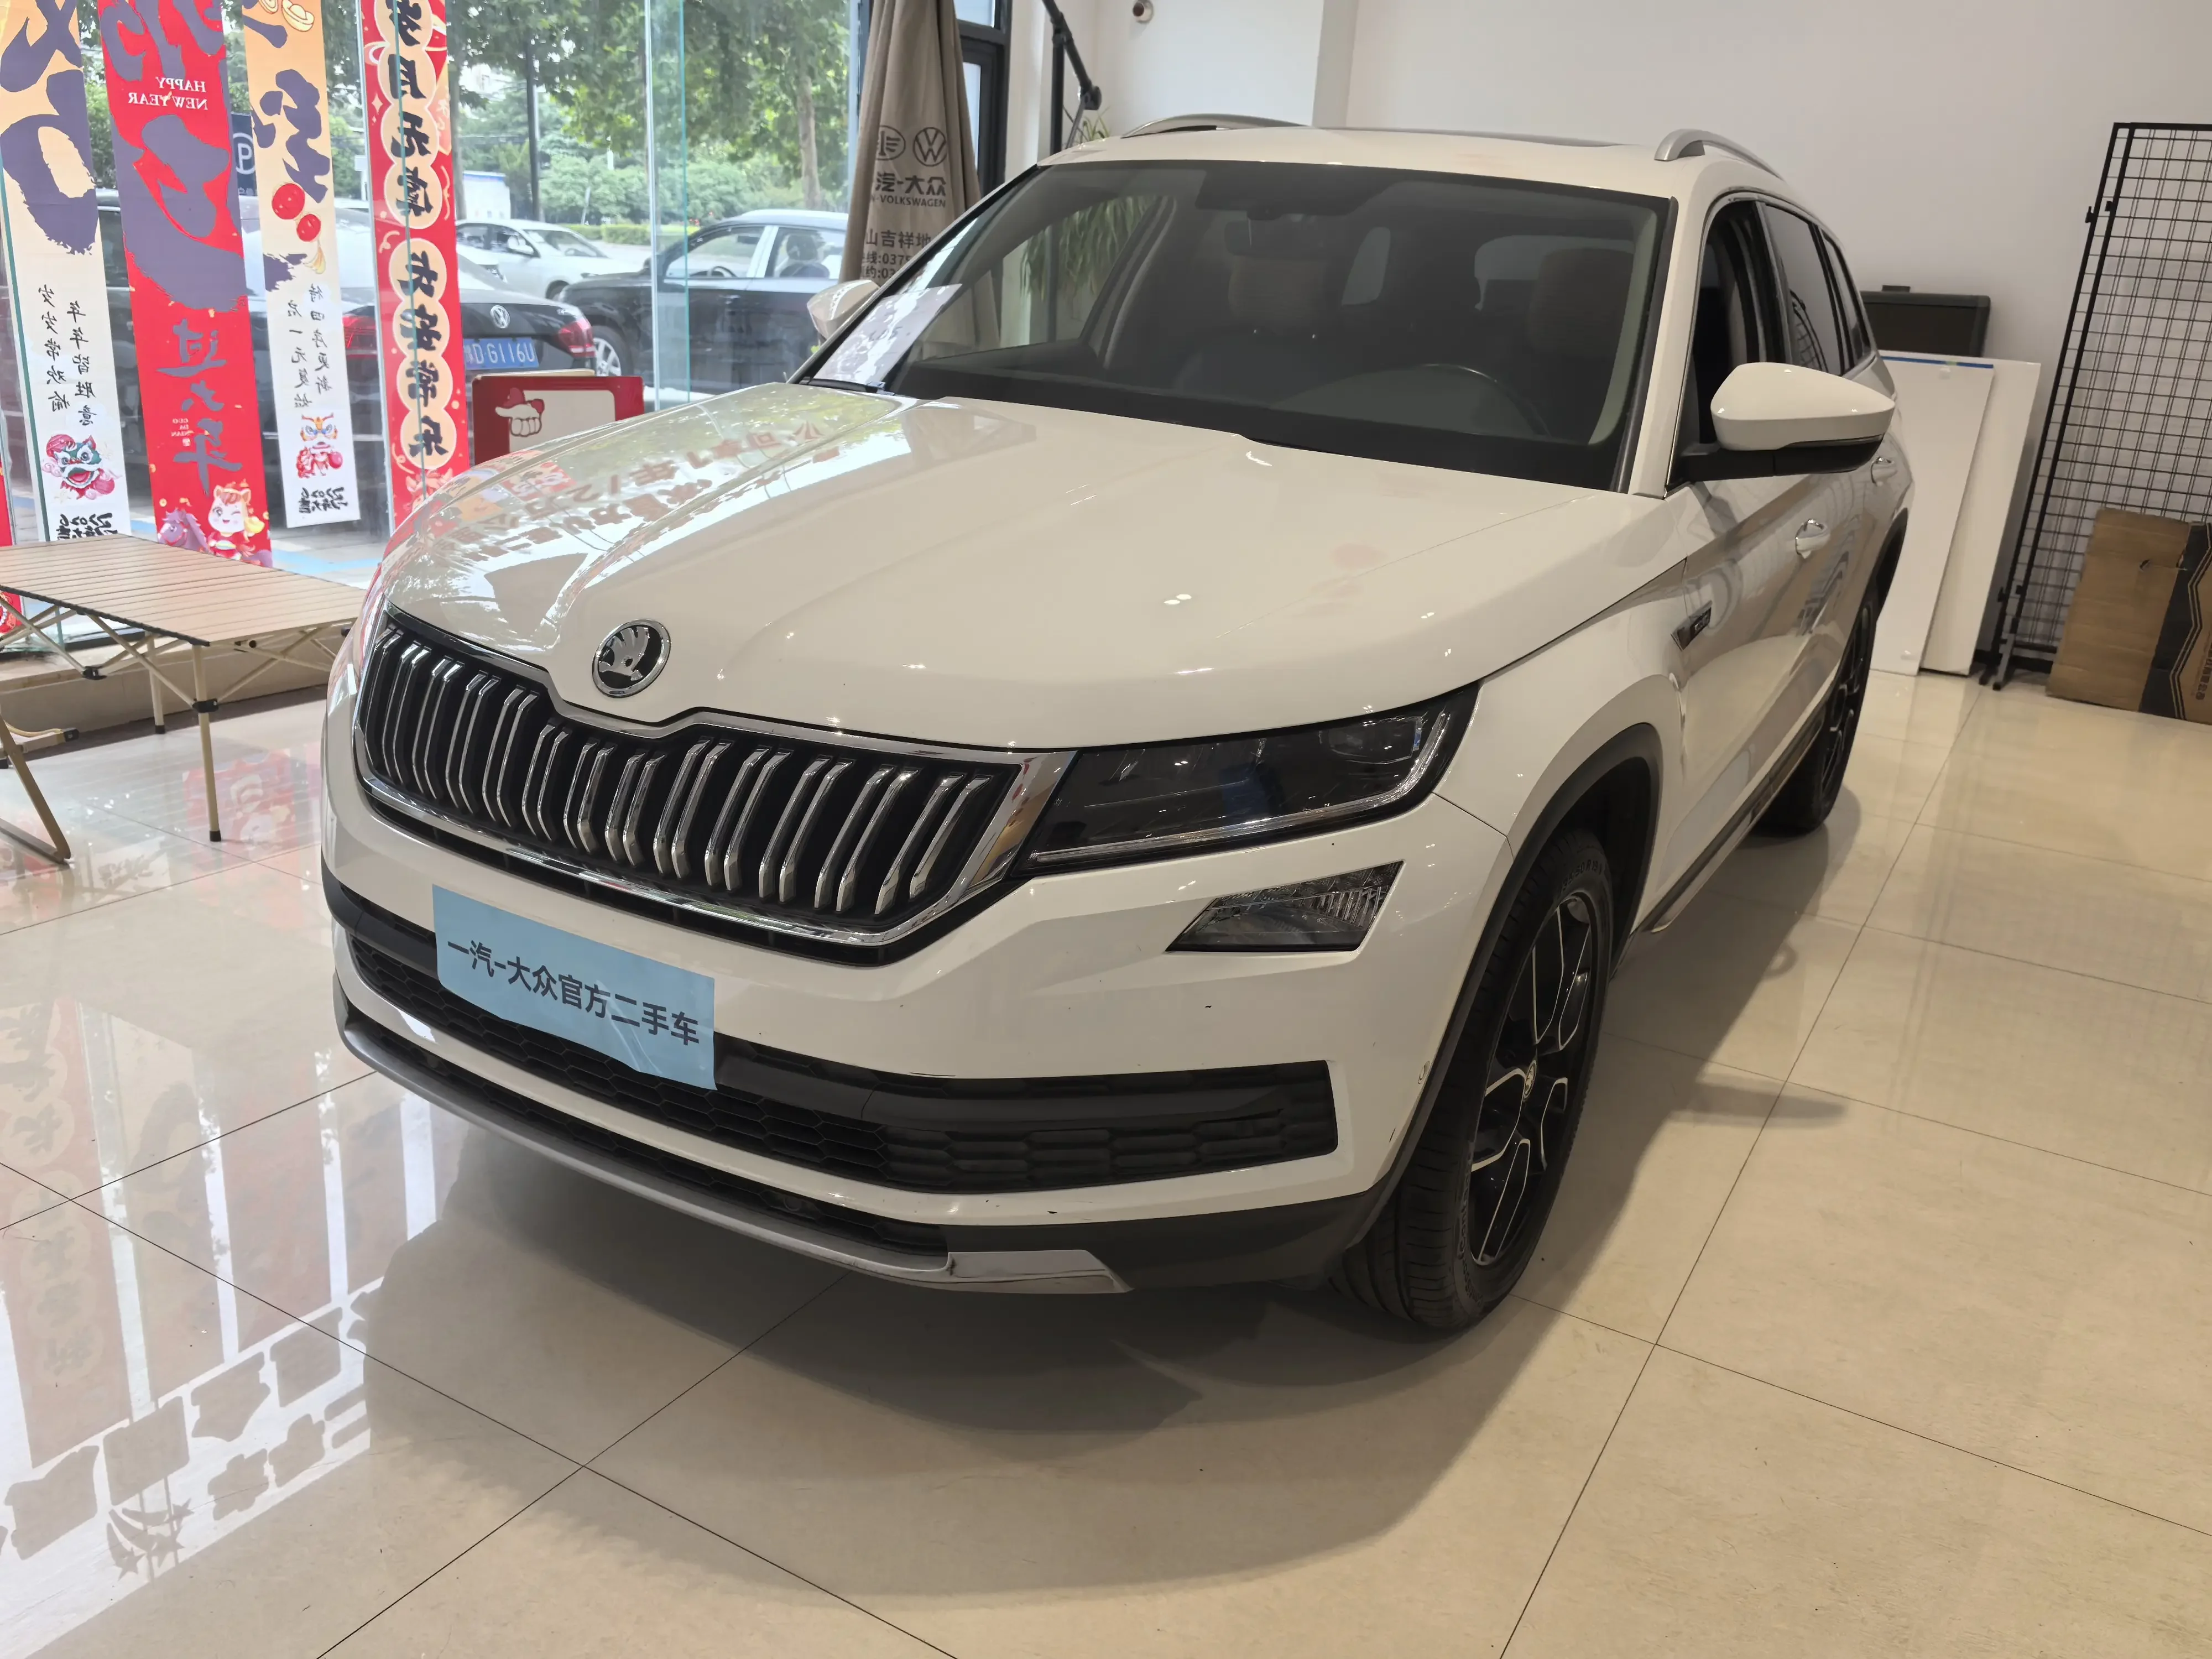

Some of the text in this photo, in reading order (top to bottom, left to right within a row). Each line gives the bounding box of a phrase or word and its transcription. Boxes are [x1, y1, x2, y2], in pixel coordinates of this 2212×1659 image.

[447, 940, 700, 1046] 一汽-大众官方二手车
